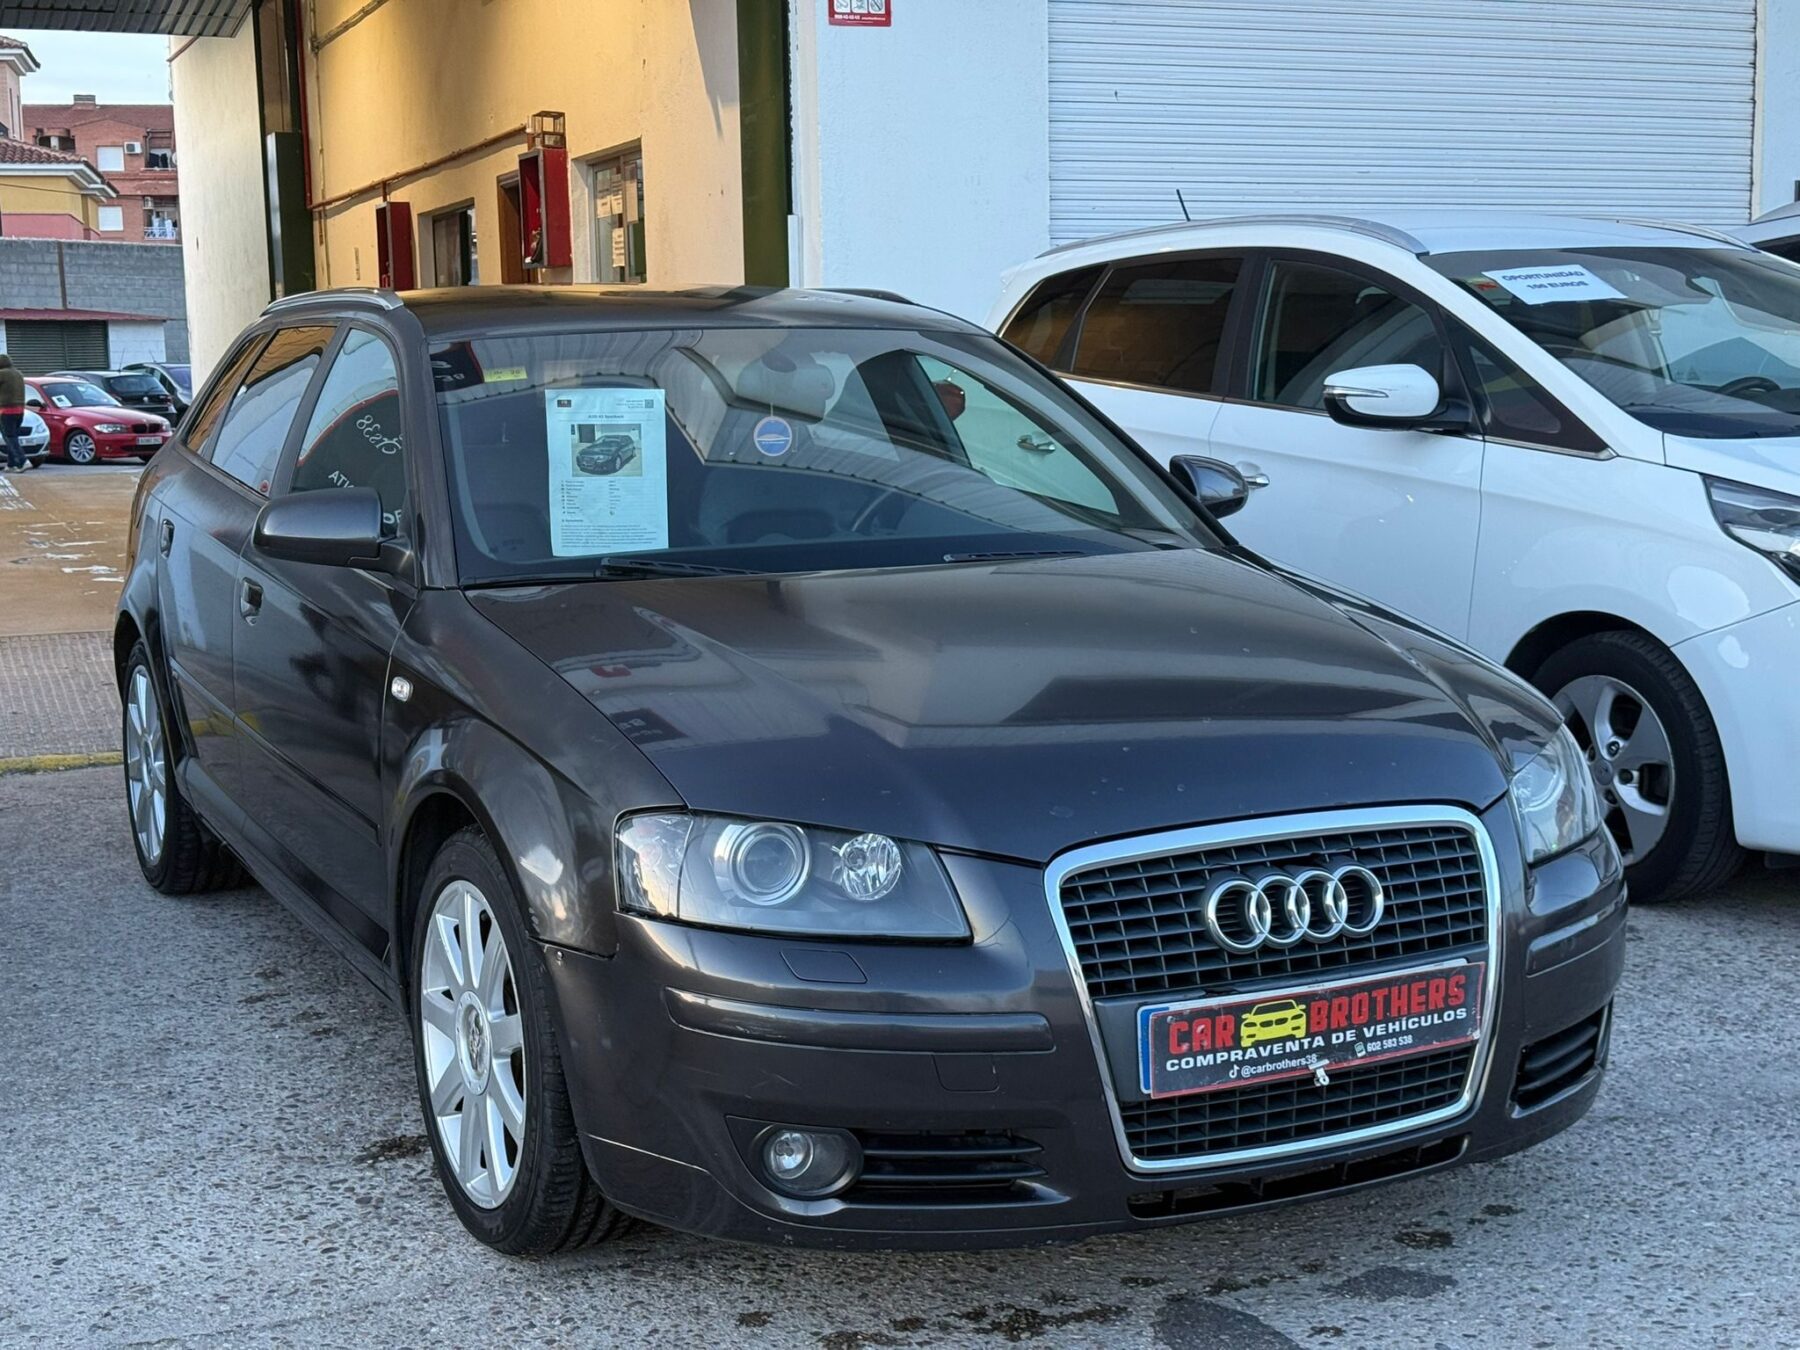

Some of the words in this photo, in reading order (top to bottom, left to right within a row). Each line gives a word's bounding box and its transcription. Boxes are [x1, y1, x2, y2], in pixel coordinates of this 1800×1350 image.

[1501, 270, 1585, 281] OPORTUNIDAD
[1169, 1014, 1235, 1055] CAR
[1309, 975, 1466, 1033] BROTHERS
[1166, 1035, 1325, 1072] COMPRAVENTA
[1331, 1029, 1357, 1044] DE
[1363, 1008, 1468, 1038] VEHÍCULOS
[1366, 1041, 1382, 1052] 602
[1383, 1037, 1398, 1049] 583
[1398, 1034, 1413, 1046] 538
[1241, 1053, 1318, 1078] @carbrothers38
